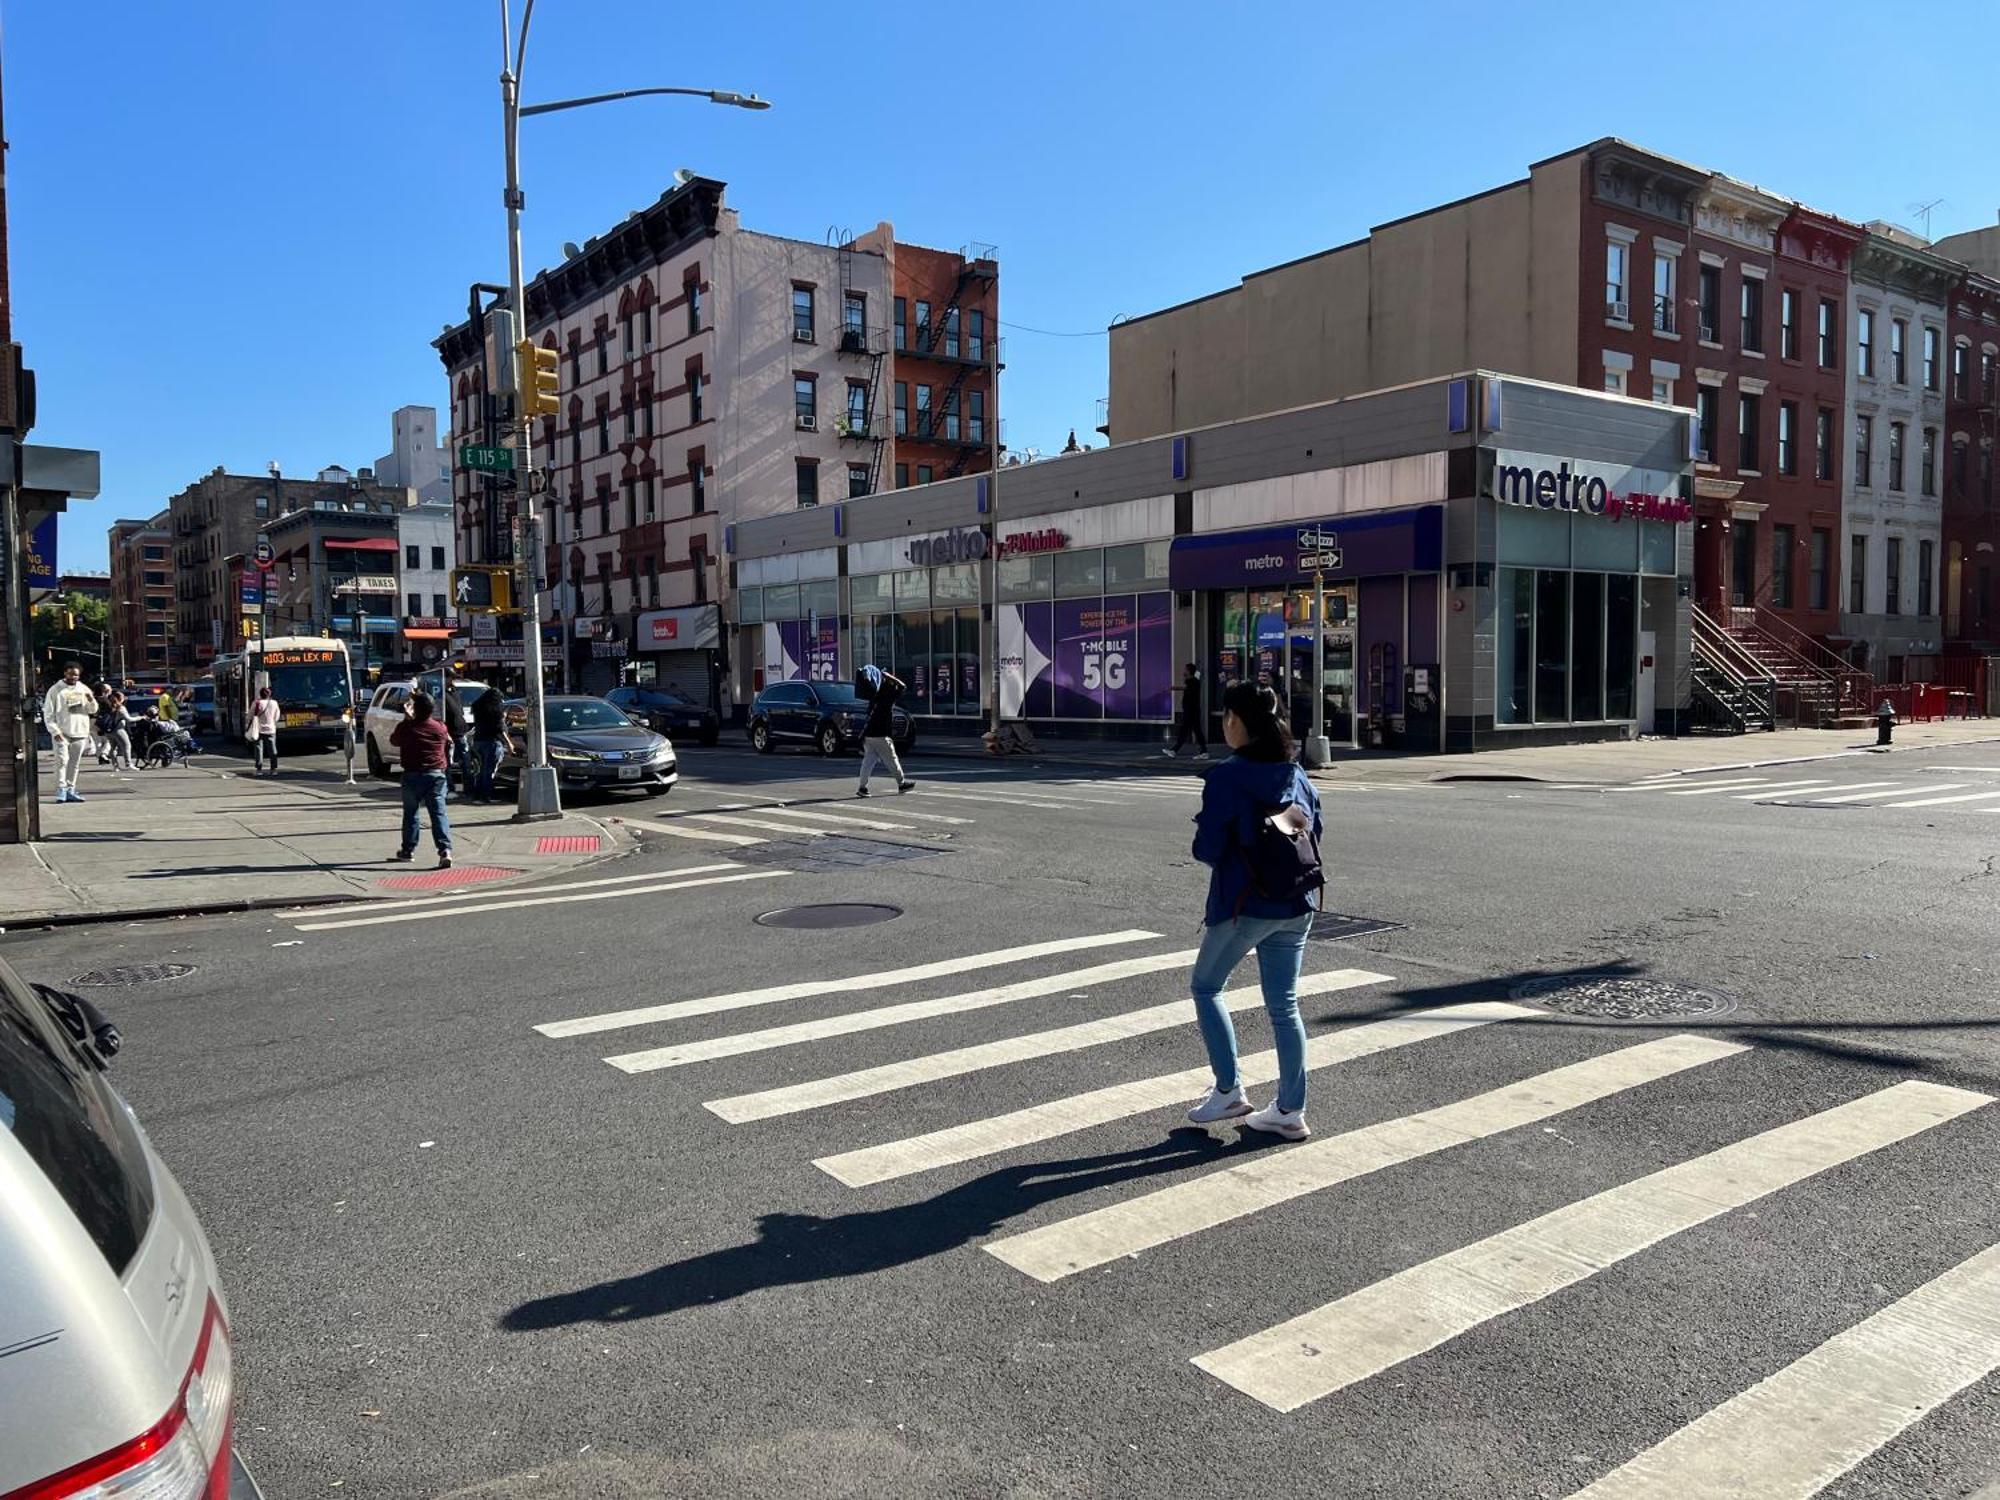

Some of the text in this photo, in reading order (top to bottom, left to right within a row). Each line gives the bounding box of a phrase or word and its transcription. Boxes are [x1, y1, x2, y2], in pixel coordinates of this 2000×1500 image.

[466, 449, 473, 465] E
[479, 450, 495, 465] 115
[1499, 462, 1607, 514] metro
[911, 526, 987, 565] metro
[1245, 554, 1284, 570] metro
[1304, 559, 1315, 567] ONE
[30, 565, 51, 576] AGE
[367, 578, 395, 588] TAXES
[1080, 640, 1128, 653] T-MOBILE
[303, 652, 319, 662] LEX
[322, 652, 333, 662] AV
[1001, 655, 1023, 666] metro
[1083, 653, 1126, 690] 5G
